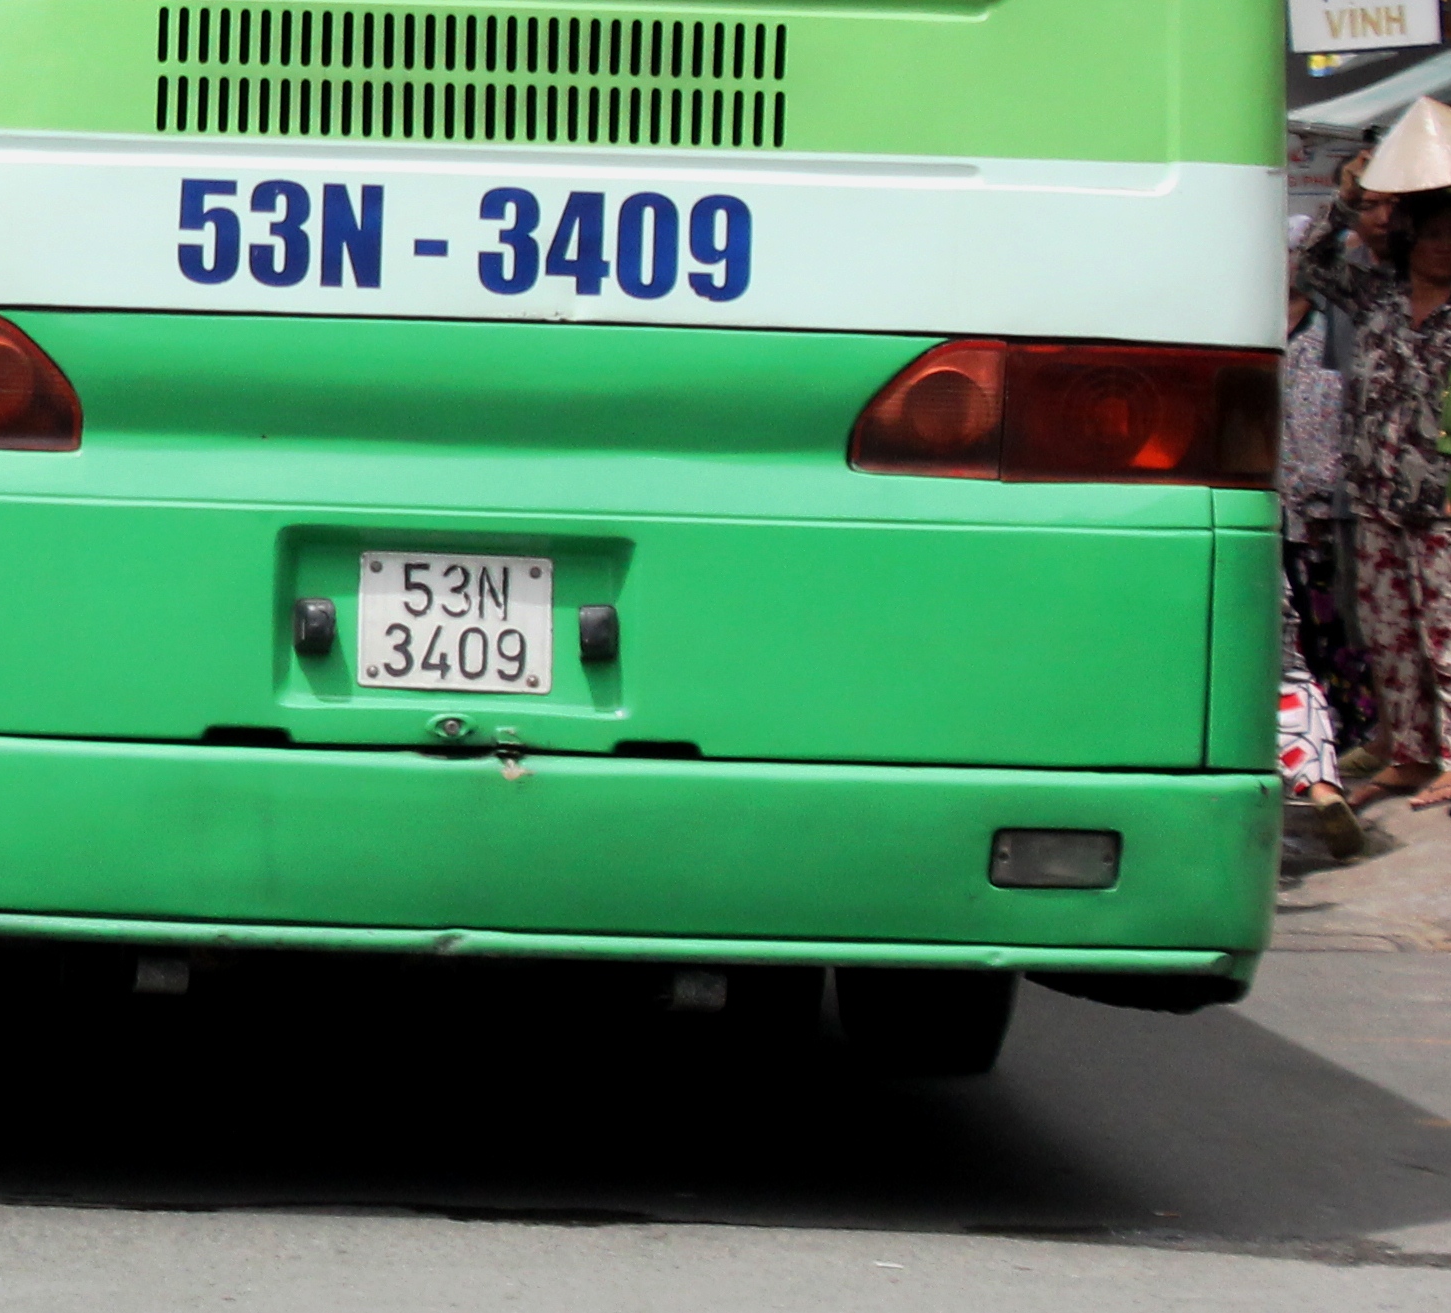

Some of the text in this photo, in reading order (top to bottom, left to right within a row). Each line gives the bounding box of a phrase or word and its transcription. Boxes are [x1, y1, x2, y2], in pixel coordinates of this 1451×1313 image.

[177, 178, 384, 289] 53N
[478, 186, 752, 302] 3409
[403, 562, 510, 621] 53N
[383, 622, 527, 682] 3409
